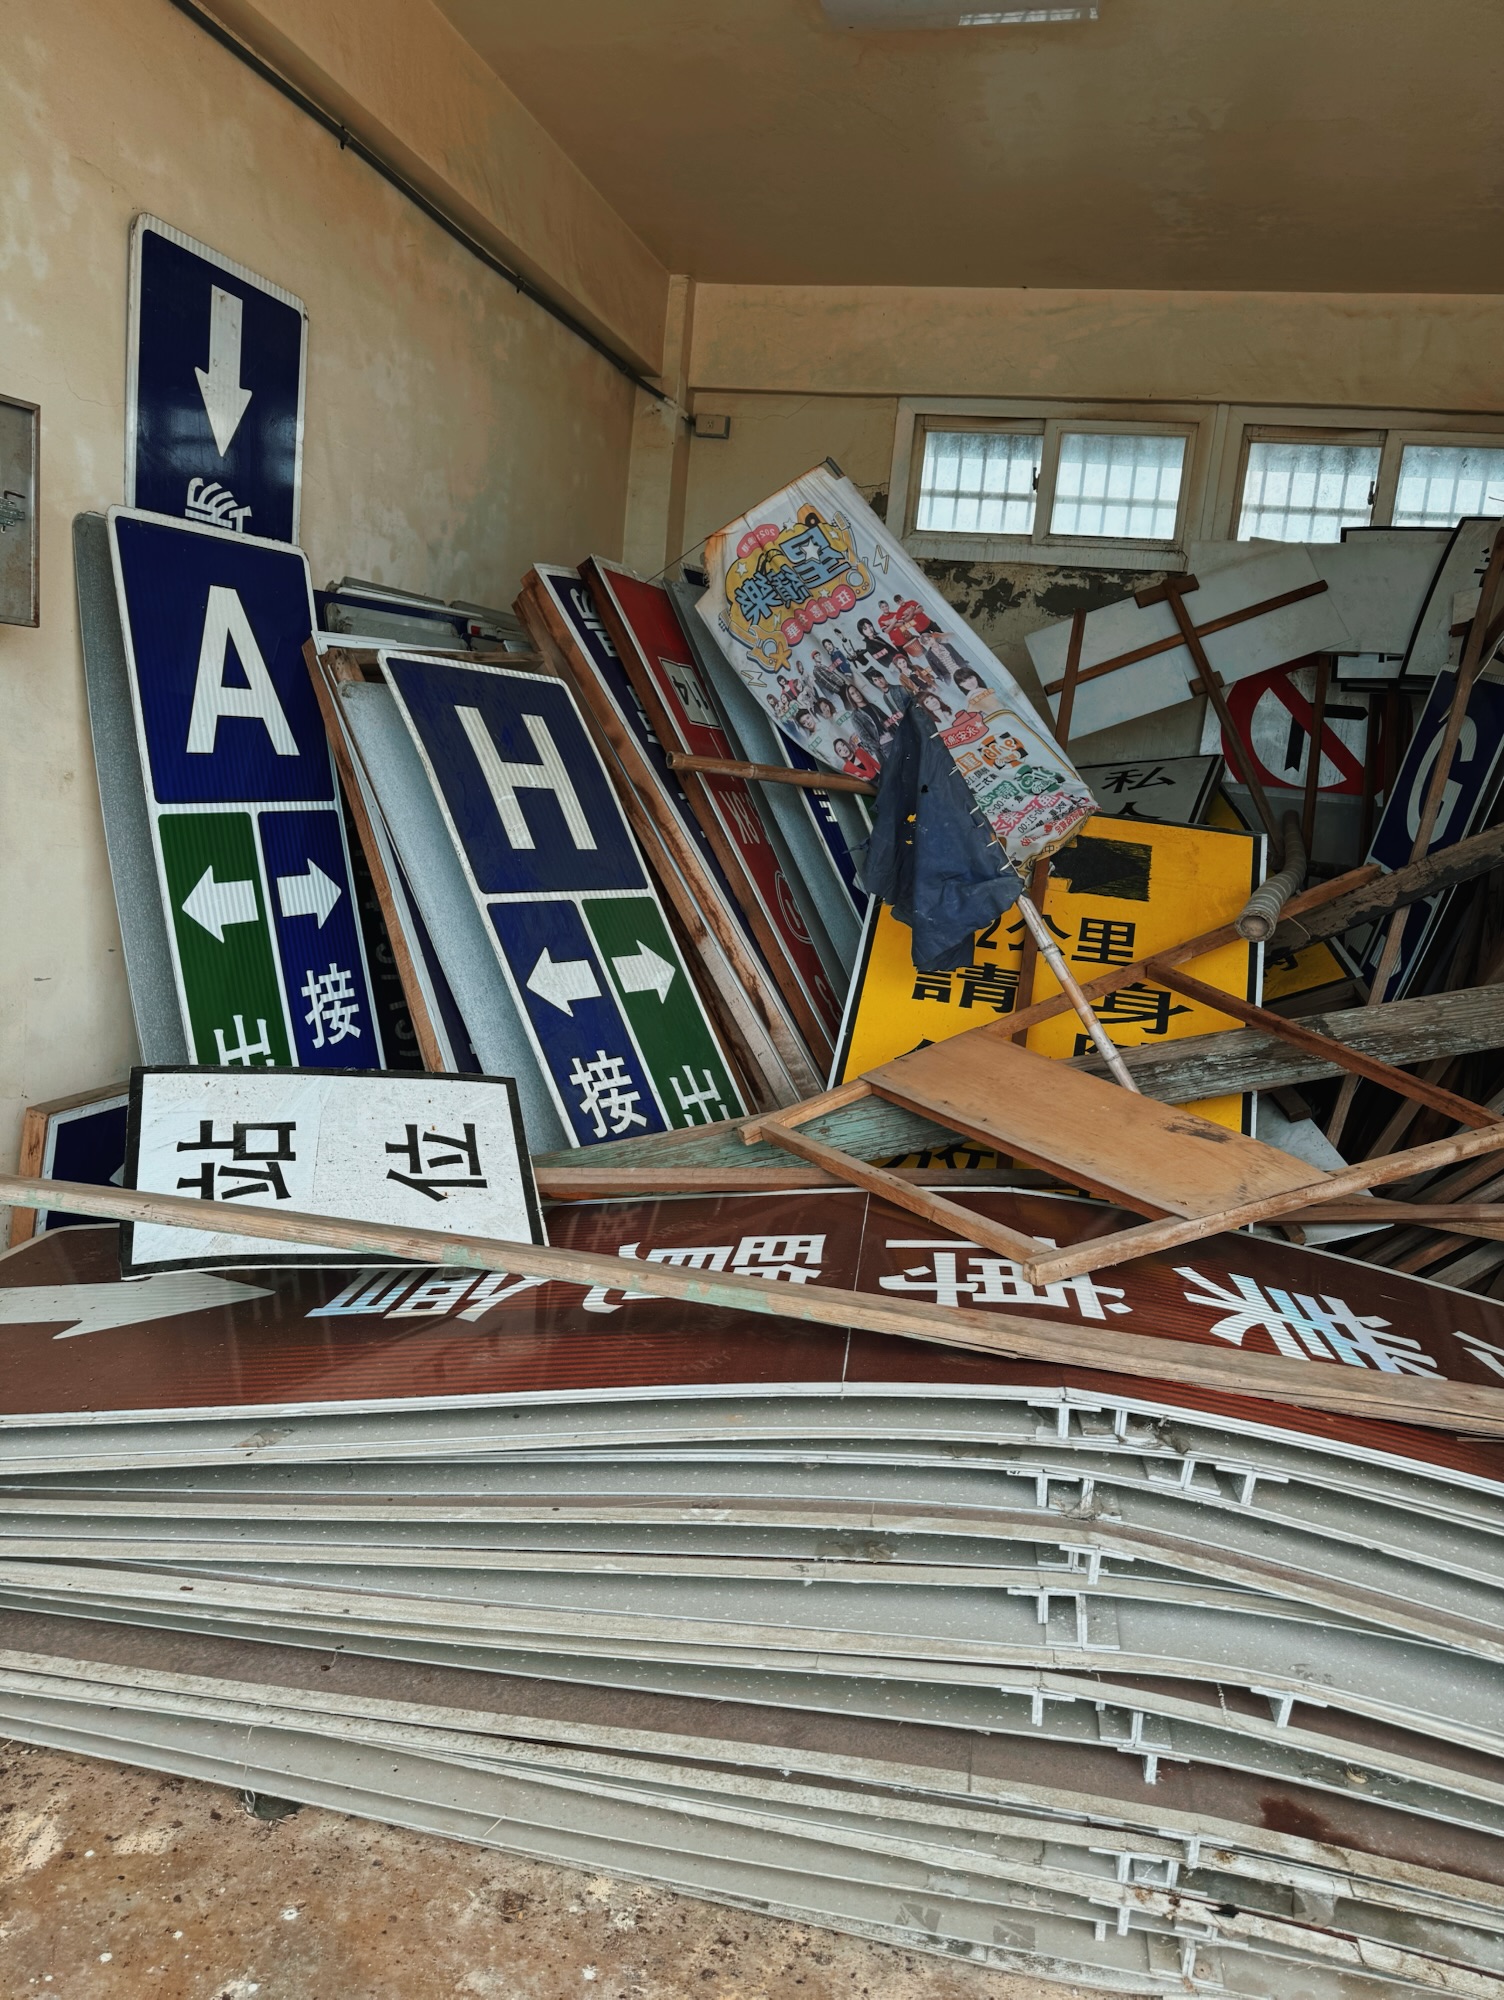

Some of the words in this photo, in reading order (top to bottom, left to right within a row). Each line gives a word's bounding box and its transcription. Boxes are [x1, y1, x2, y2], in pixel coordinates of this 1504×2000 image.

[186, 585, 300, 756] A
[671, 675, 708, 710] 114
[453, 705, 597, 850] H
[1406, 714, 1477, 845] G
[301, 962, 362, 1048] 接
[569, 1050, 648, 1138] 接
[177, 1120, 488, 1202] 站位
